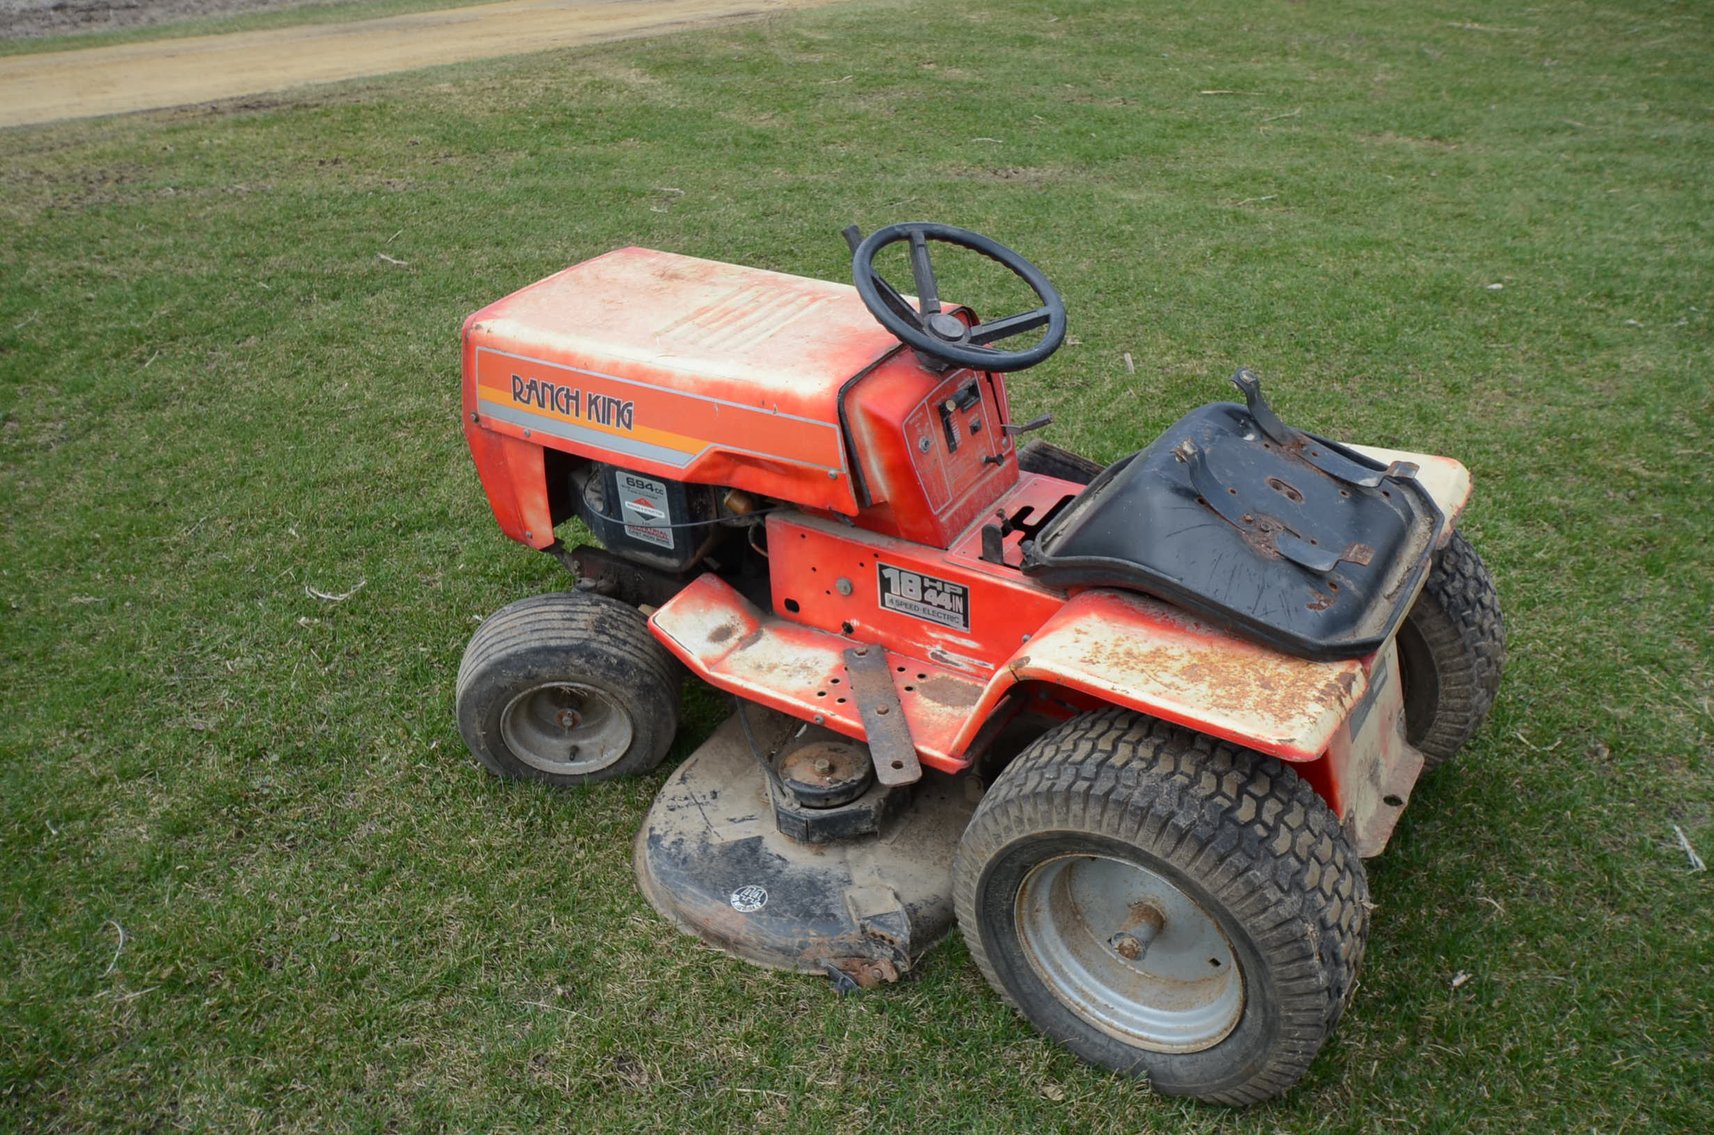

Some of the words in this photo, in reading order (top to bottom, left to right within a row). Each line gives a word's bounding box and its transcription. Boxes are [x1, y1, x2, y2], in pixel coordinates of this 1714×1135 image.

[512, 374, 581, 418] RANCH
[587, 392, 634, 431] KING
[882, 568, 922, 601] 18
[924, 577, 962, 594] HP
[895, 599, 920, 612] SPEED
[923, 608, 960, 624] ELECTRIC
